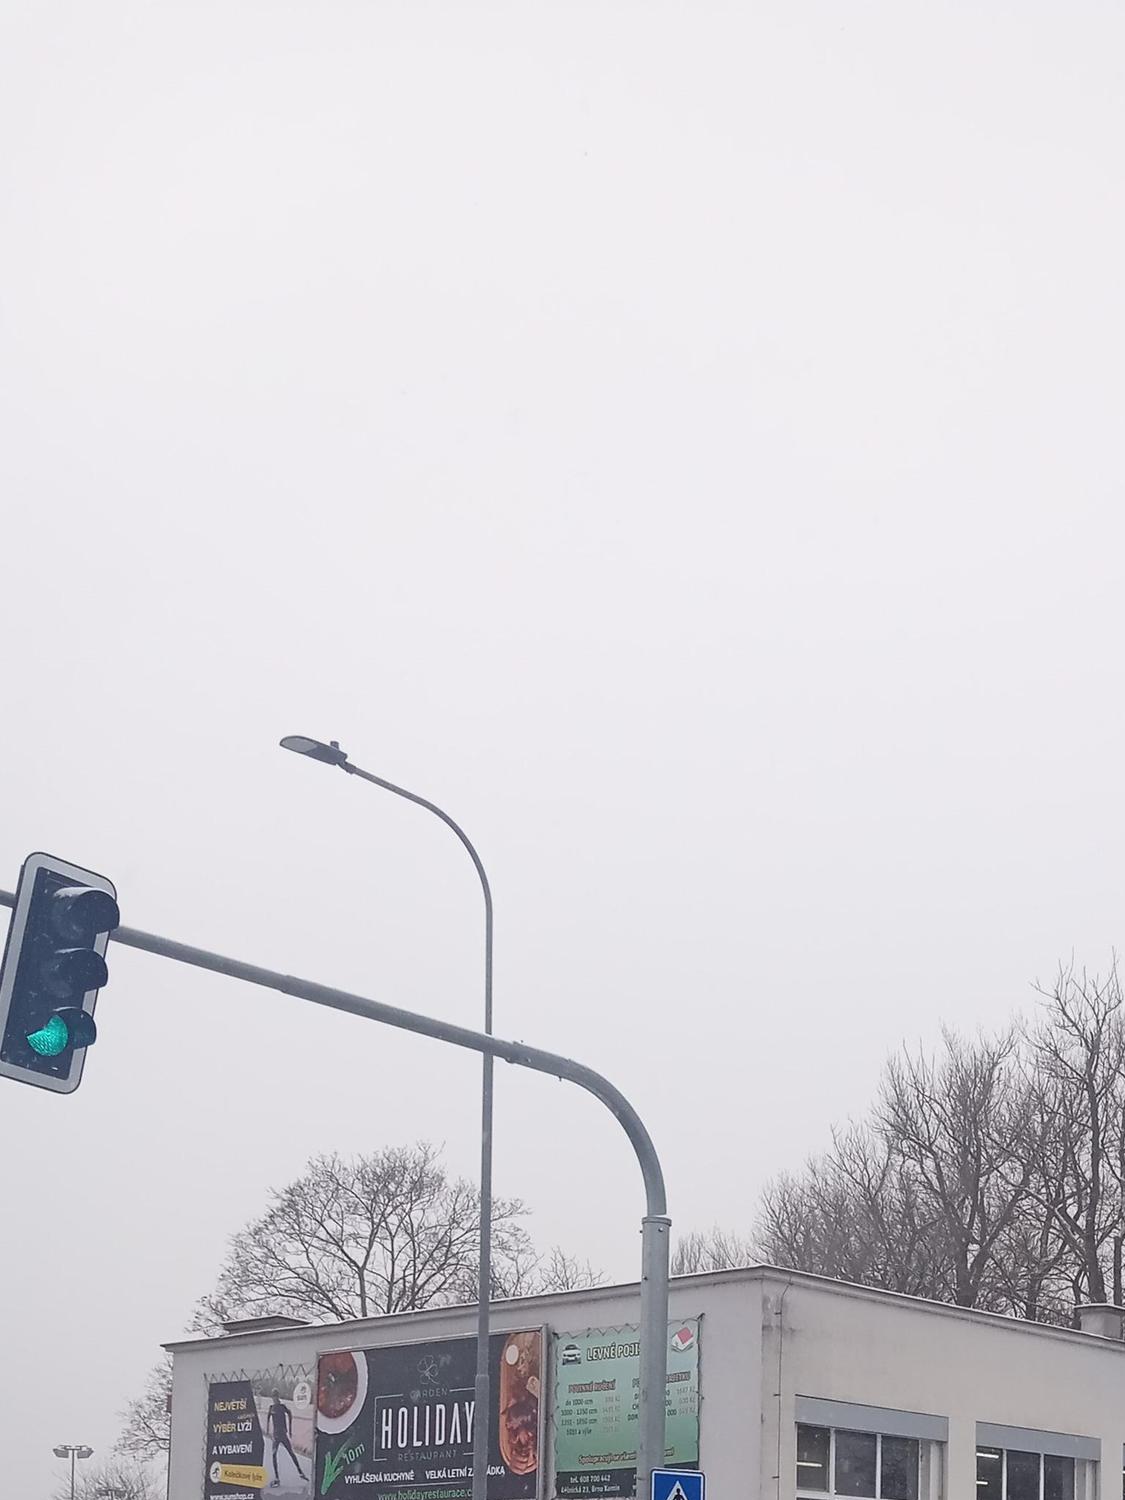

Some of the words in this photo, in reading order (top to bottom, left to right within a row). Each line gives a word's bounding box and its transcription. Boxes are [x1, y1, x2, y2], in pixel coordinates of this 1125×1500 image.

[586, 1342, 616, 1361] LEVNÉ
[617, 1342, 640, 1359] POJI
[381, 1401, 475, 1449] HOLIDAY
[212, 1446, 218, 1455] A
[345, 1471, 383, 1484] VYHLÁŠENÁ
[425, 1467, 446, 1480] VELKÁ
[447, 1466, 467, 1478] LETNÍ
